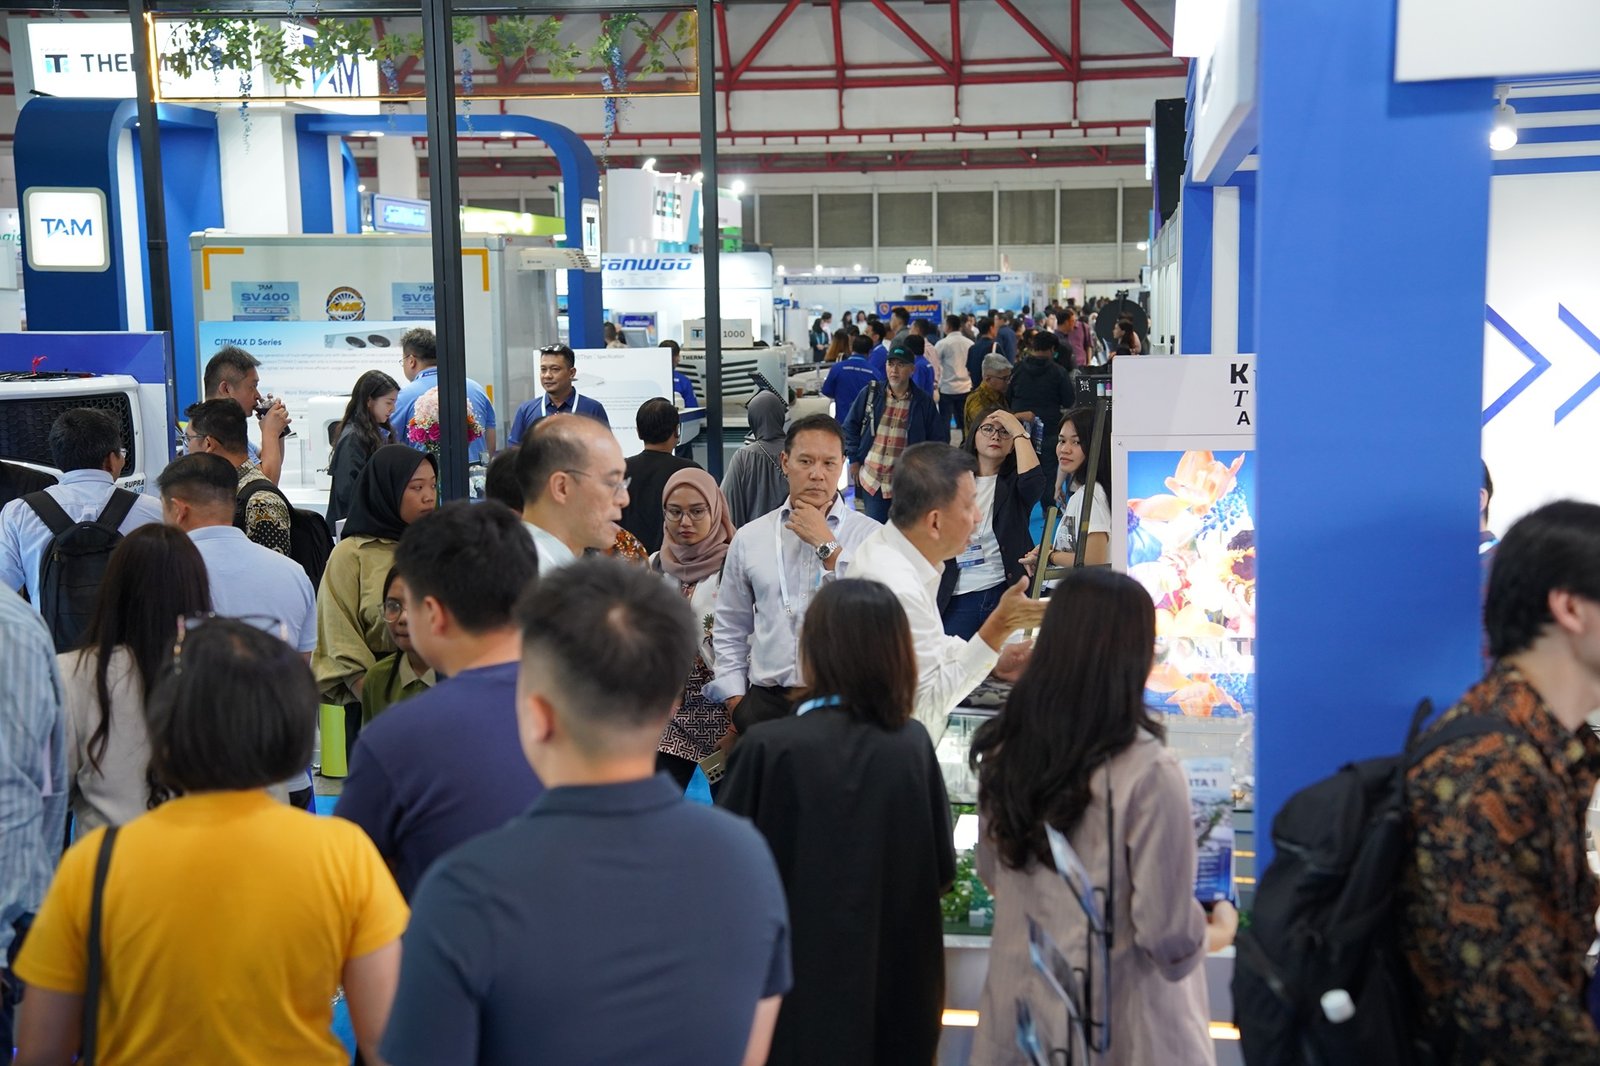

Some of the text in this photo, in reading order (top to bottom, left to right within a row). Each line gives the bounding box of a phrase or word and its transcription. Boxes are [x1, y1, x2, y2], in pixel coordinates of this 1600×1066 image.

[40, 217, 93, 238] TAM
[241, 292, 290, 301] SV400
[401, 293, 435, 302] SV6
[723, 330, 746, 338] 1000
[214, 338, 282, 346] CITIMAX D Series
[1230, 363, 1249, 384] K
[1233, 389, 1249, 408] T
[1236, 410, 1251, 426] A
[124, 479, 145, 489] SUPRA
